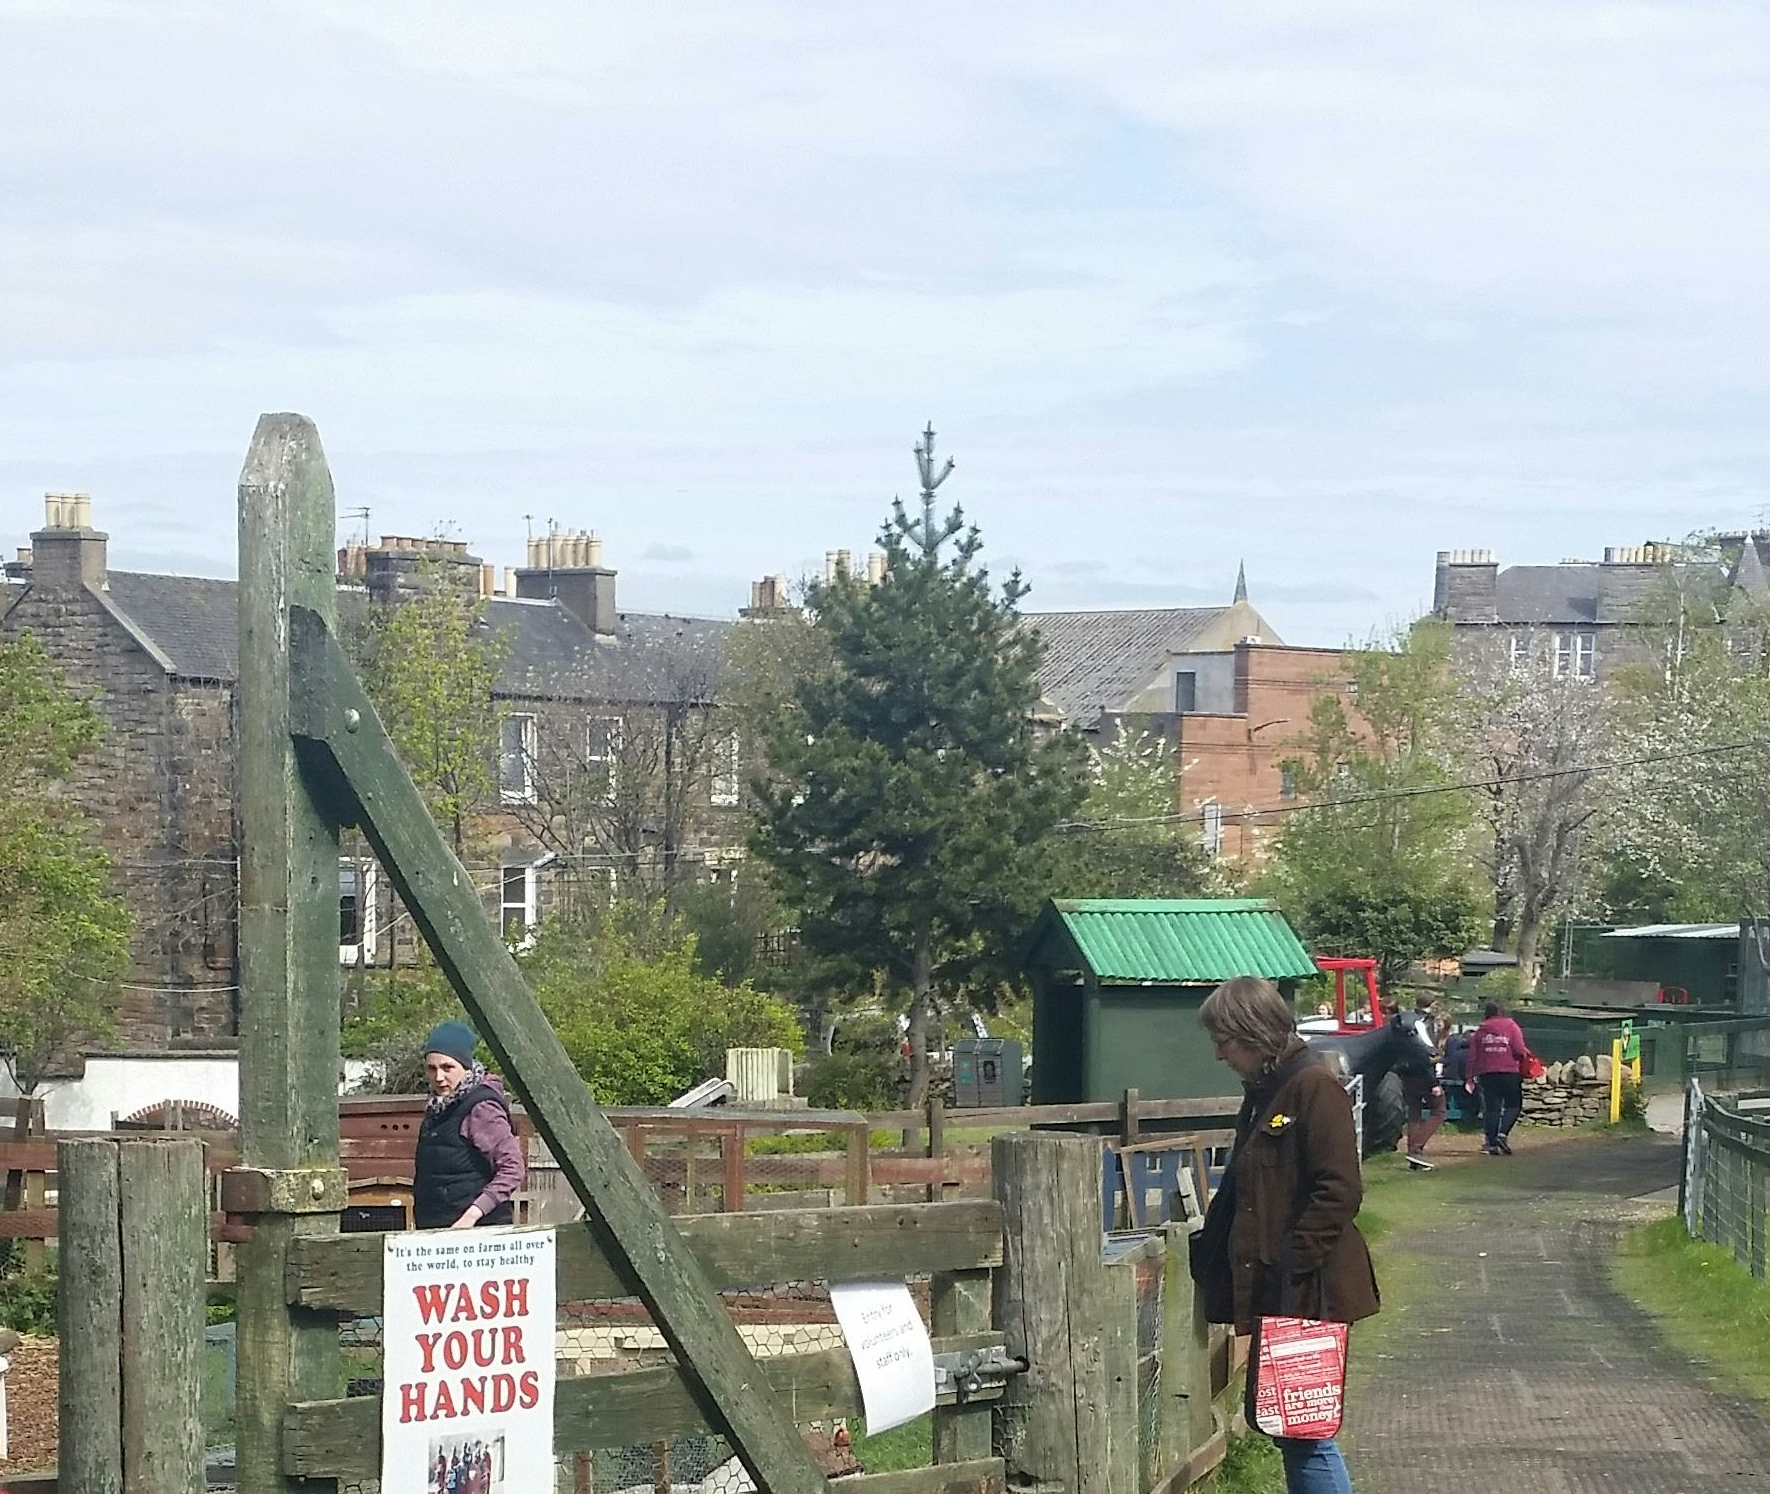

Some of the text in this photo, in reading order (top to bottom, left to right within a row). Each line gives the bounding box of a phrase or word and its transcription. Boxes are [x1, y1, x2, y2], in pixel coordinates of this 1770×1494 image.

[396, 1240, 545, 1258] It's the same on farms all over
[407, 1255, 535, 1272] the world, to stay healthy
[412, 1278, 530, 1326] WASH
[415, 1325, 526, 1374] YOUR
[399, 1370, 539, 1424] HANDS
[1283, 1382, 1341, 1402] friends
[1284, 1396, 1334, 1411] are more
